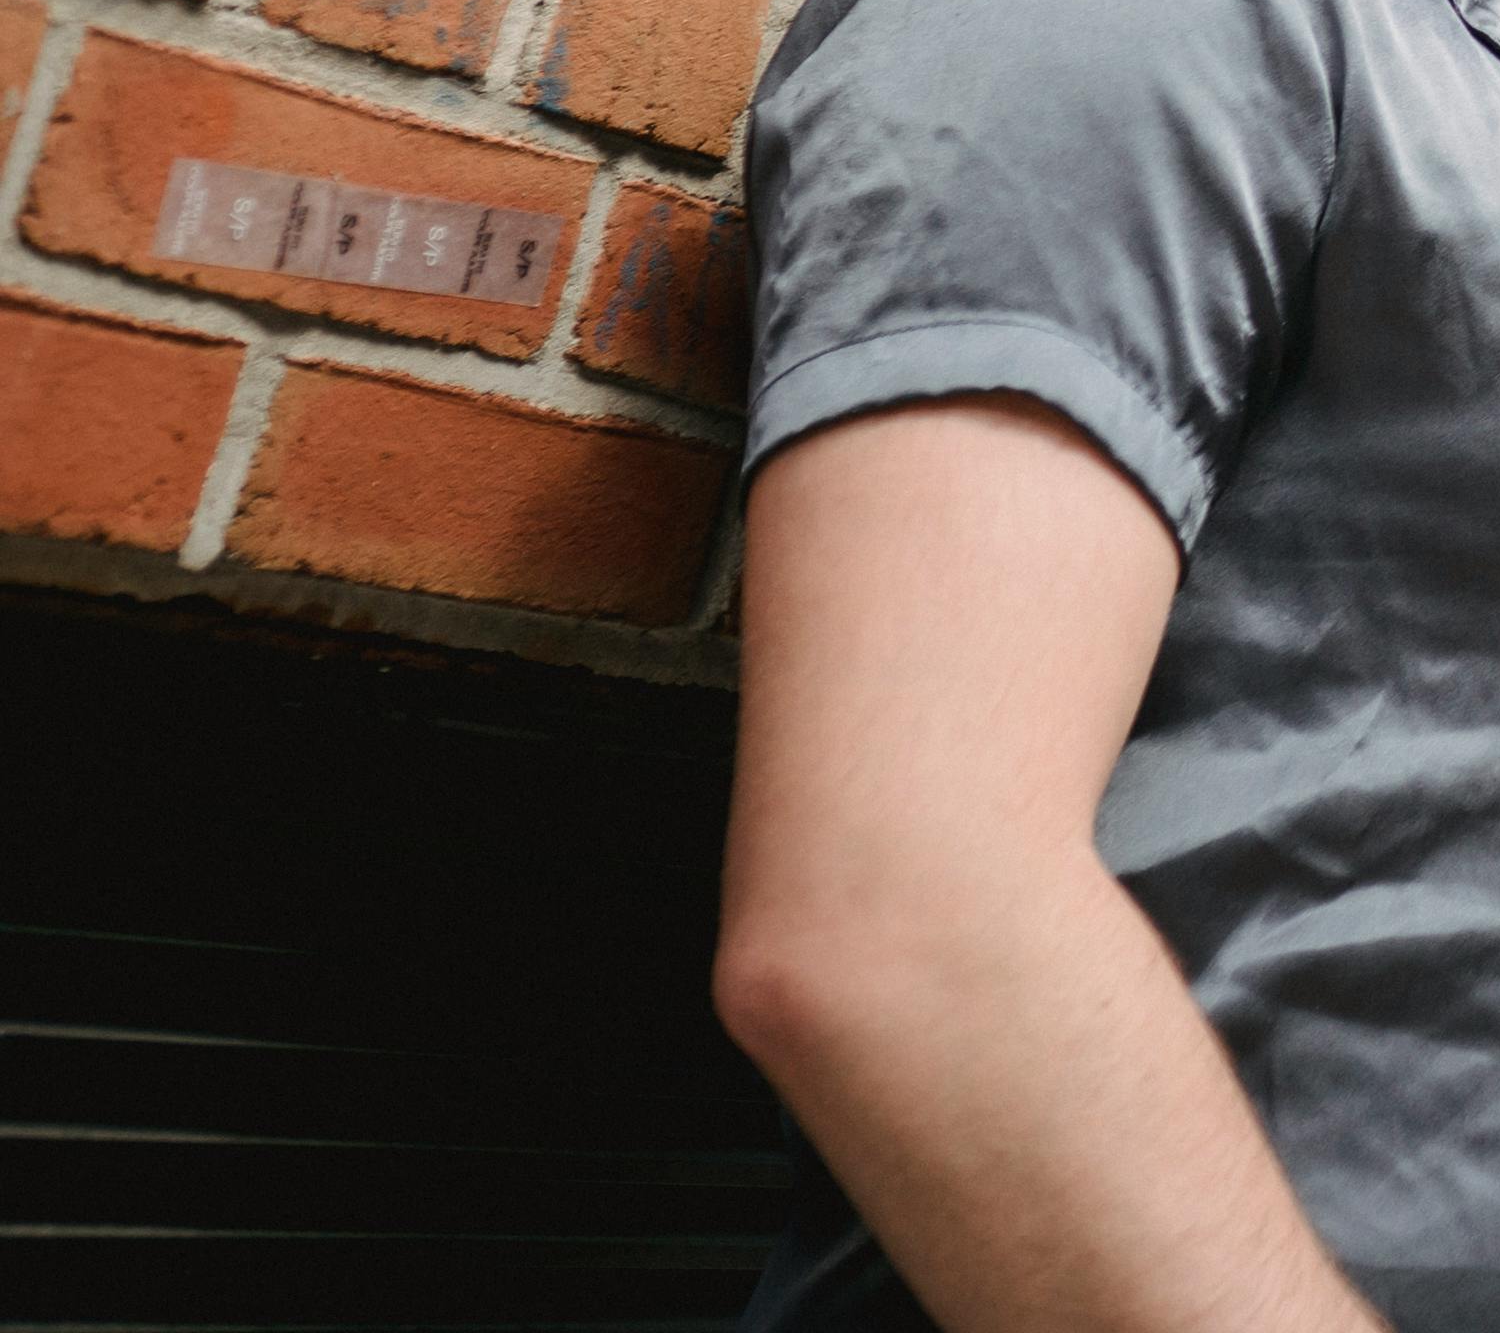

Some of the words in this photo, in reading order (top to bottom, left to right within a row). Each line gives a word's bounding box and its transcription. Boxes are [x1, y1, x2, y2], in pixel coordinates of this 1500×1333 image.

[229, 196, 257, 241] S/P
[335, 213, 358, 256] S/P
[422, 224, 449, 267] S/P
[516, 239, 541, 280] S/P
